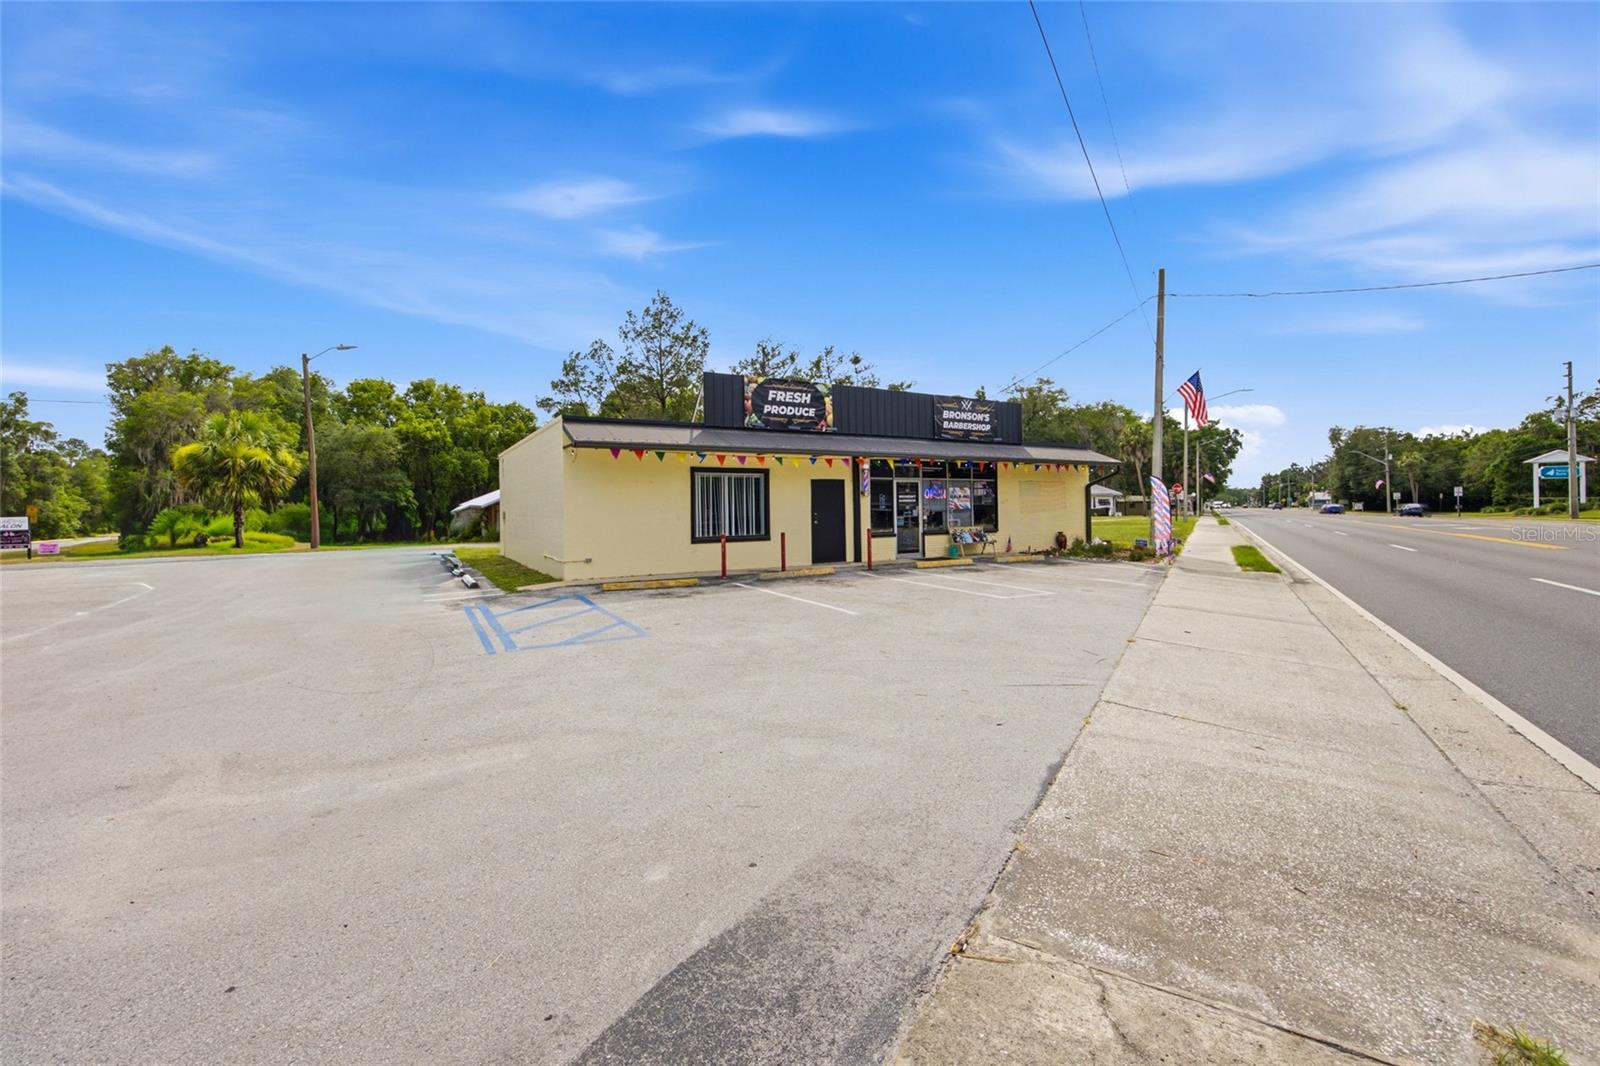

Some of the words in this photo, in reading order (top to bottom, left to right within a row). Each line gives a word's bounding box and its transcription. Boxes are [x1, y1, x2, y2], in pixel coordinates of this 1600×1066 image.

[768, 390, 811, 404] FRESH
[763, 404, 816, 417] PRODUCE
[943, 410, 990, 422] BRONSON'S
[943, 421, 991, 432] BARBERSHOP
